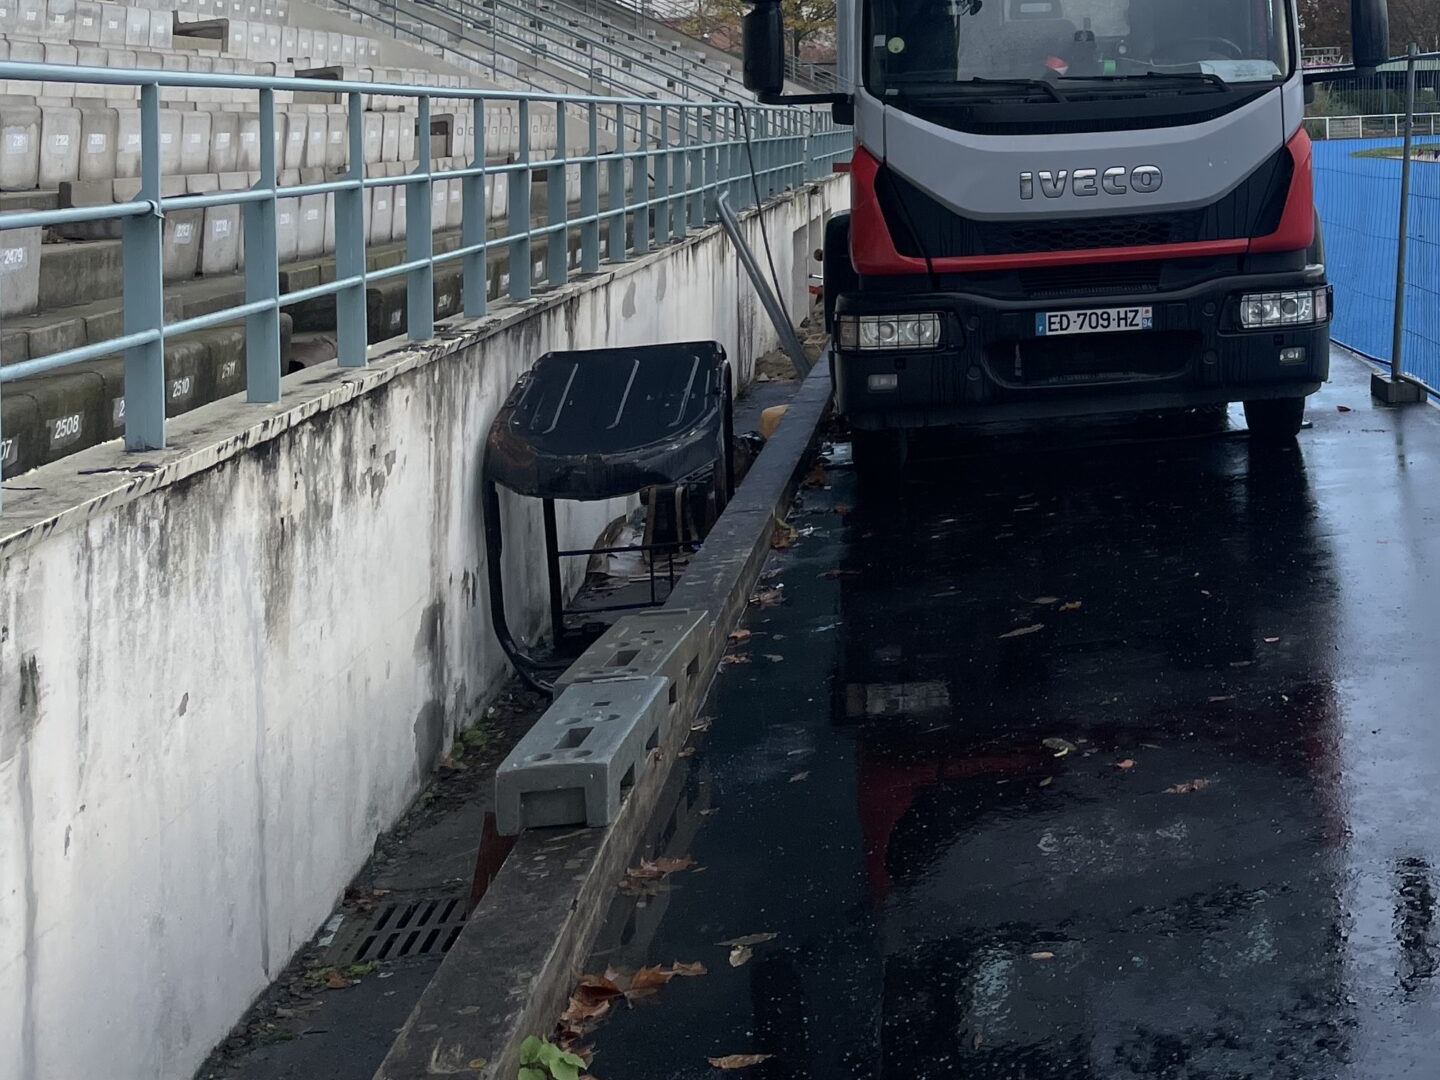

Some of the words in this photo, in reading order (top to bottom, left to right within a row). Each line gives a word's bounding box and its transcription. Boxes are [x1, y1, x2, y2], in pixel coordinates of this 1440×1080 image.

[1020, 164, 1163, 200] IVECO
[4, 247, 23, 265] 2479
[1047, 309, 1140, 332] ED-709-HZ
[1142, 318, 1152, 328] 94
[221, 361, 236, 379] 2511
[172, 377, 190, 398] 2510
[54, 414, 80, 439] 2508
[0, 440, 12, 460] 07
